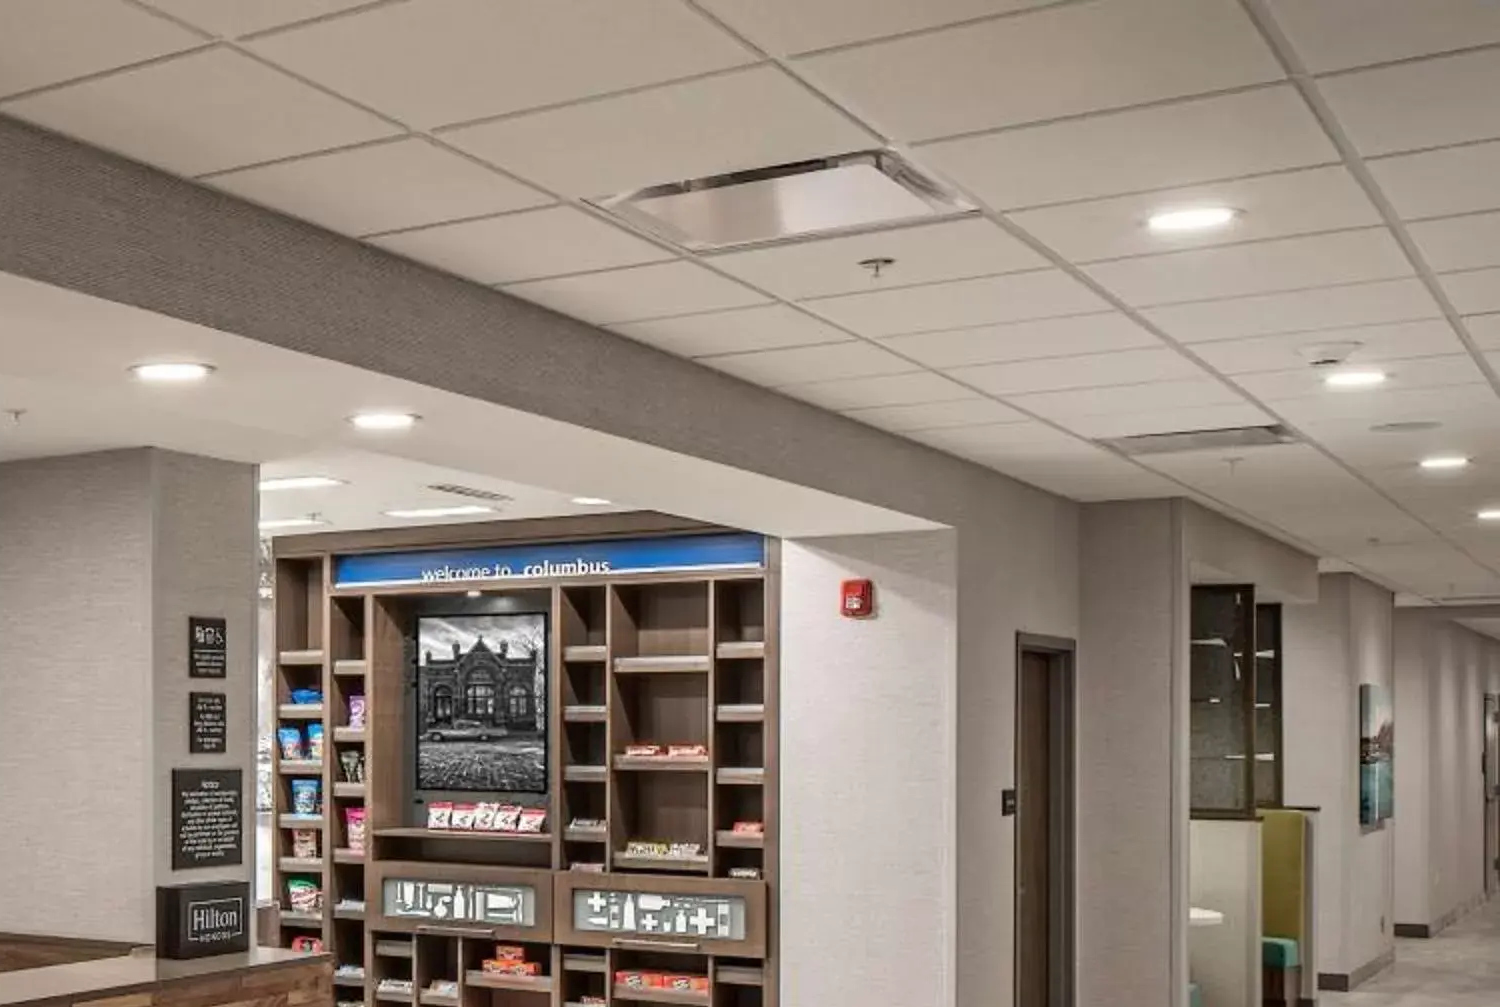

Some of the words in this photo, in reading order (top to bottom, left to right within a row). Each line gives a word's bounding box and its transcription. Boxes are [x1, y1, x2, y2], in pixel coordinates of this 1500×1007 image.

[421, 565, 490, 582] welcome
[495, 563, 511, 578] to
[523, 558, 611, 578] columbus
[193, 907, 237, 931] Hilton
